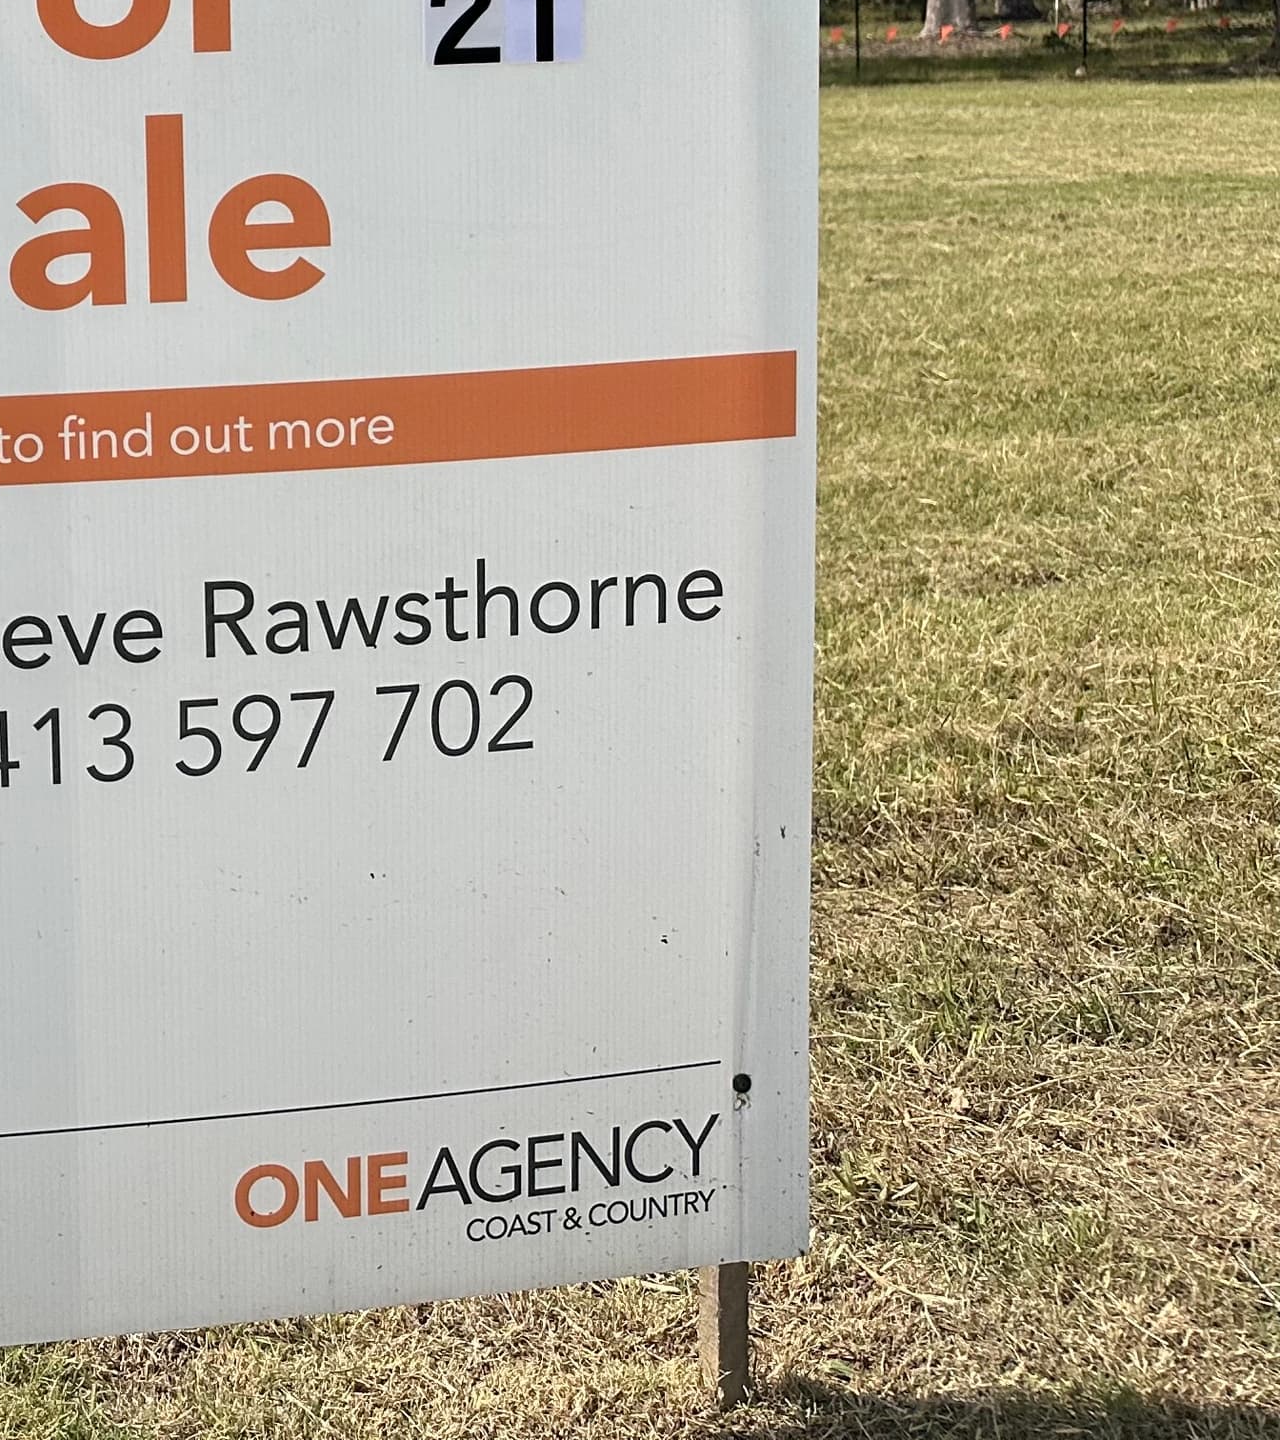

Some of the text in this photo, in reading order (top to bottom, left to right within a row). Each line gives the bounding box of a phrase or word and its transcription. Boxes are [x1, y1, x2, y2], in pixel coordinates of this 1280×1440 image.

[59, 415, 154, 461] find
[169, 414, 254, 456] out
[268, 410, 396, 450] more
[203, 559, 724, 660] Rawsthorne
[174, 690, 336, 776] 597
[376, 674, 535, 761] 702
[466, 1190, 716, 1243] COAST & COUNTRY
